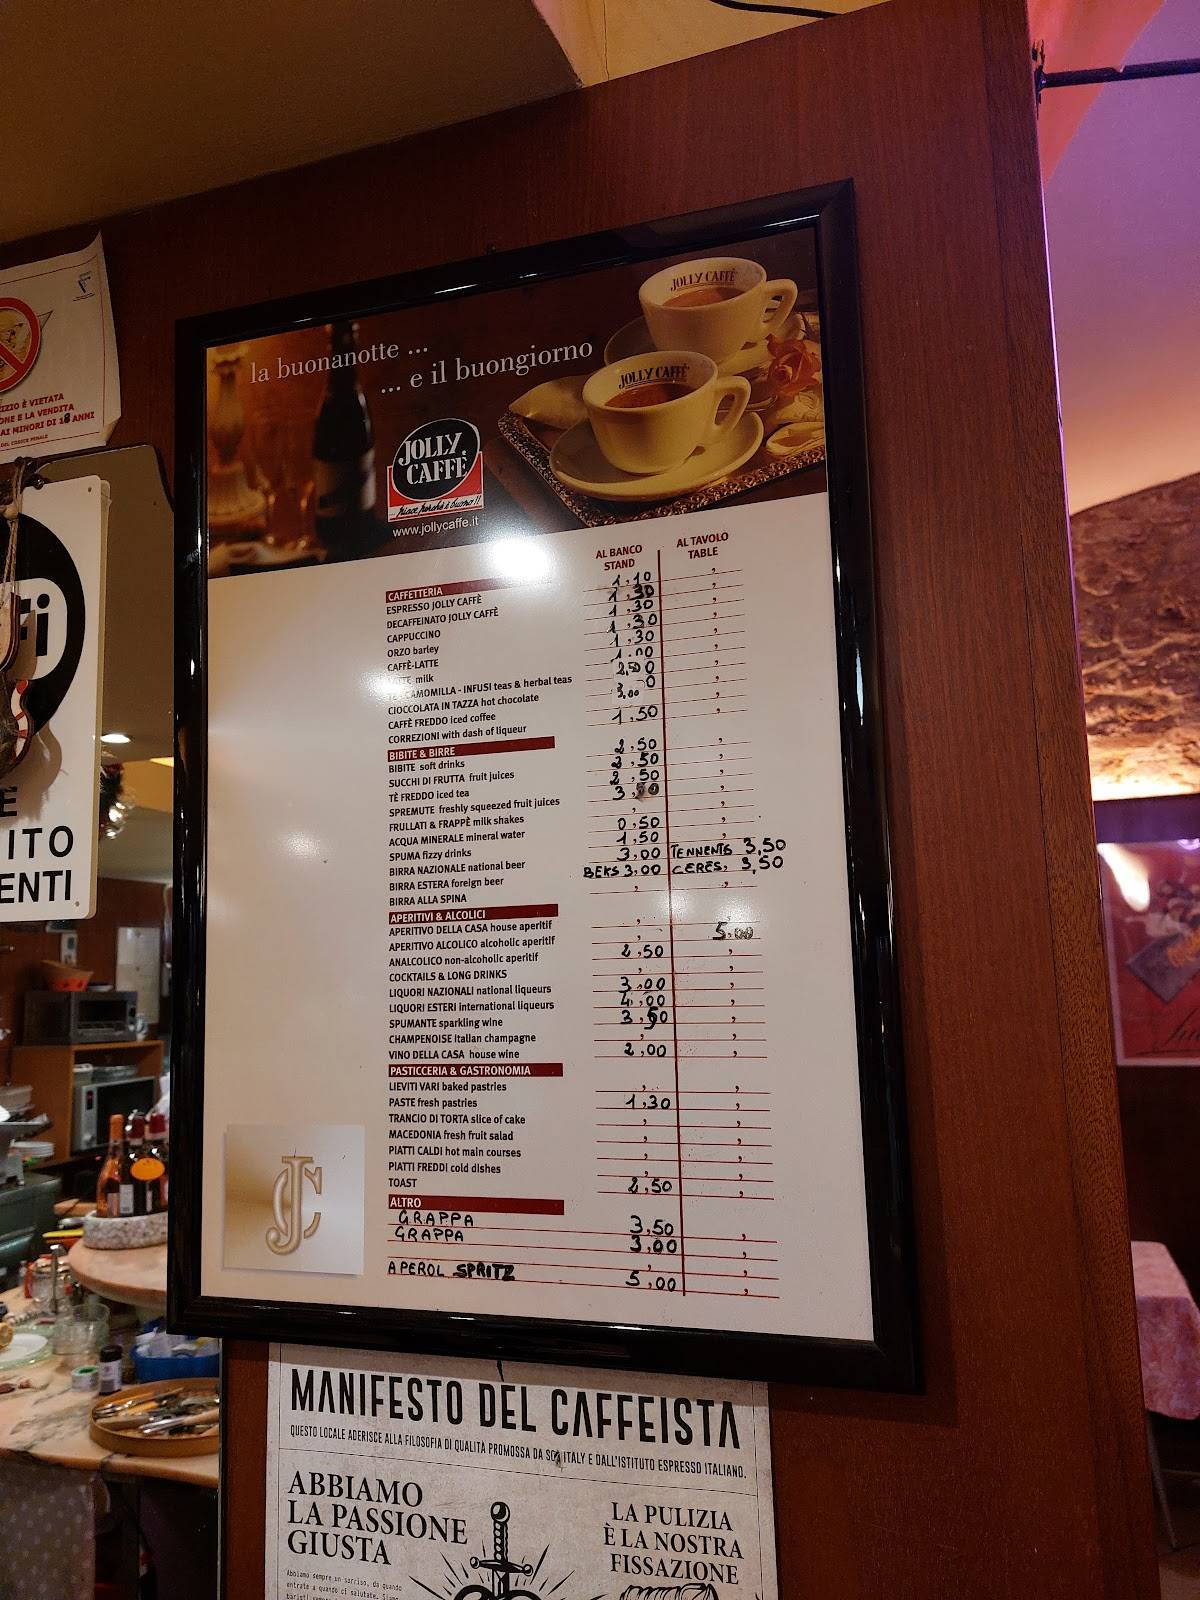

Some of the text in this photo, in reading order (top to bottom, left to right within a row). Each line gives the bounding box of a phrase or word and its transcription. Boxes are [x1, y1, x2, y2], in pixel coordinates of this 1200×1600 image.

[250, 363, 270, 384] la
[278, 343, 400, 378] buonanotte
[410, 372, 423, 388] e
[431, 360, 448, 385] il
[456, 341, 593, 382] buongiorno
[618, 368, 656, 389] JOLLY
[30, 393, 64, 406] VIETATA
[38, 404, 74, 416] VENDITA
[13, 422, 44, 434] MINORI
[72, 412, 94, 422] ANNI
[398, 432, 462, 466] JOLLY
[407, 450, 467, 484] CAFFÈ
[393, 516, 478, 537] www.jollycaffe.it
[677, 532, 729, 548] AL TAVOLO
[610, 544, 642, 556] BANCO
[688, 547, 718, 559] TABLE
[604, 559, 635, 570] STAND
[388, 587, 443, 601] CAFFETTERIA
[387, 594, 482, 615] ESPRESSO JOLLY CAFFÈ
[387, 607, 498, 628] DECAFFEINATO JOLLY CAFFÈ
[387, 630, 441, 643] CAPPUCCINO
[388, 645, 439, 657] ORZO barley
[388, 659, 439, 671] CAFFÈ-LATTE
[388, 694, 539, 715] CIOCCOLATA IN TAZZA hot chocolate
[388, 725, 527, 743] CORREZIONI with dash of liqueur
[389, 747, 455, 760] BIBITE & BIRRE
[389, 771, 514, 787] SUCCHI DI FRUTTA fruit juices
[389, 798, 560, 817] SPREMUTE freshly squeezed fruit juices
[389, 830, 525, 847] ACQUA MINERALE mineral water
[389, 861, 525, 876] BIRRA NAZIONALE national beer
[583, 866, 619, 878] BEKS
[391, 910, 486, 923] APERITIVI & ALCOLICI
[389, 952, 539, 966] ANALCOLICO non-alcoholic aperitif
[389, 1001, 554, 1013] LIQUORI ESTERI international liqueurs
[389, 1034, 536, 1044] CHAMPENOISE Italian champagne
[390, 1066, 531, 1075] PASTICCERIA & GASTRONOMIA
[389, 1130, 513, 1141] MACEDONIA fresh fruit salad
[389, 1178, 417, 1188] TOAST
[390, 1197, 421, 1208] ALTRO
[398, 1210, 474, 1226] GRAPPA
[395, 1226, 464, 1242] GRAPPA
[453, 1262, 515, 1281] SPRITZ
[291, 1369, 740, 1449] MANIFESTO DEL CAFFEISTA
[291, 1424, 317, 1438] QUESTO
[320, 1428, 345, 1440] LOCALE
[349, 1430, 382, 1443] ADERISCE
[385, 1433, 402, 1446] ALLA
[406, 1435, 442, 1449] FILOSOFIA
[445, 1439, 452, 1450] DI
[455, 1440, 486, 1453] QUALITÀ
[488, 1442, 530, 1459] PROMOSSA
[533, 1448, 543, 1460] DA
[563, 1451, 585, 1465] ITALY
[589, 1454, 593, 1464] E
[596, 1454, 655, 1471] DALL'ISTITUTO
[658, 1459, 701, 1474] ESPRESSO
[704, 1462, 747, 1479] ITALIANO.
[288, 1471, 423, 1508] ABBIAMO
[288, 1500, 468, 1545] LA PASSIONE
[611, 1502, 733, 1531] LA PULIZIA
[287, 1530, 391, 1565] GIUSTA
[603, 1523, 744, 1559] È LA NOSTRA
[610, 1553, 739, 1584] FISSAZIONE
